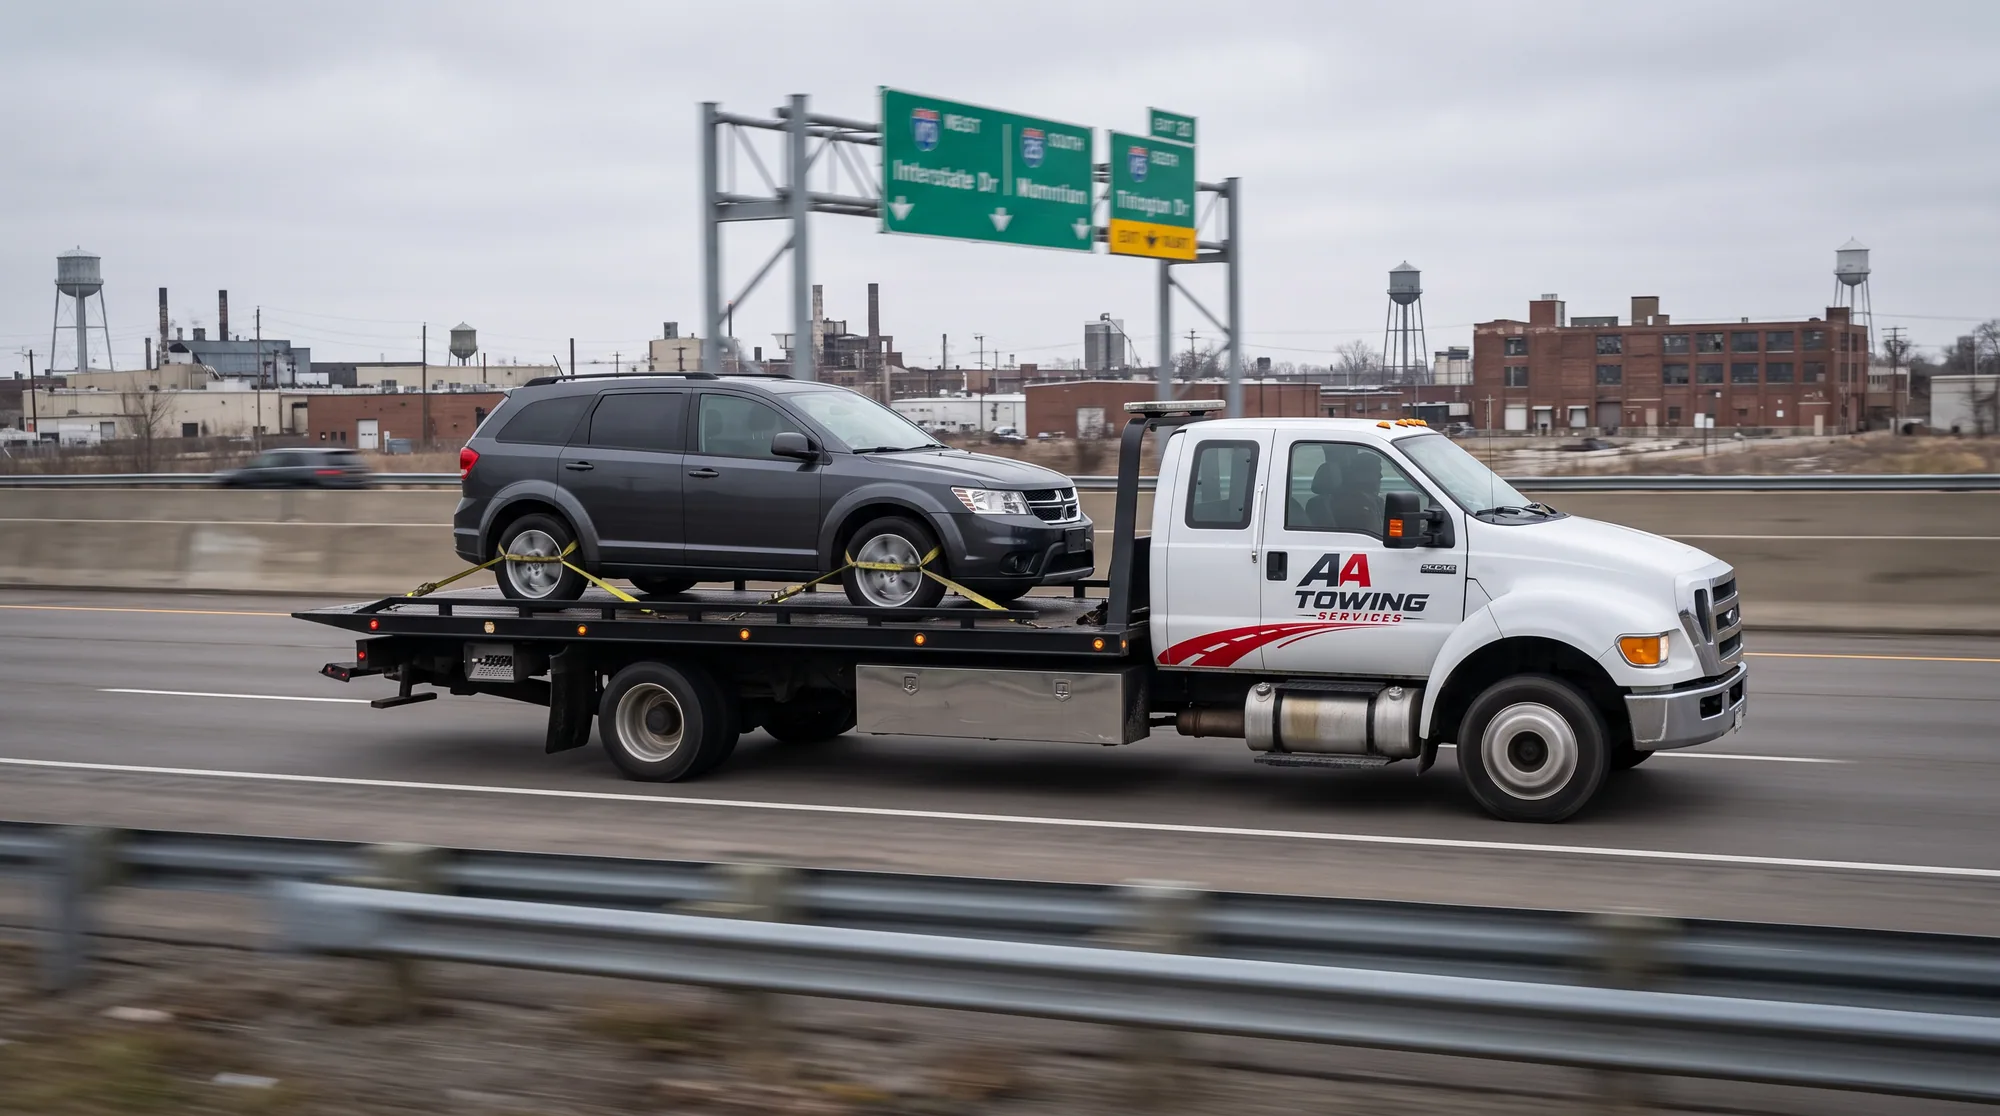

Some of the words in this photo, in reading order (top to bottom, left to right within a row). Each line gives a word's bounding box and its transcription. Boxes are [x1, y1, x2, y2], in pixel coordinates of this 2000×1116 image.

[893, 160, 975, 190] Interstate
[977, 172, 999, 193] Dr
[1296, 553, 1371, 588] AA
[1295, 591, 1430, 612] TOWING
[1317, 612, 1402, 623] SERVICES
